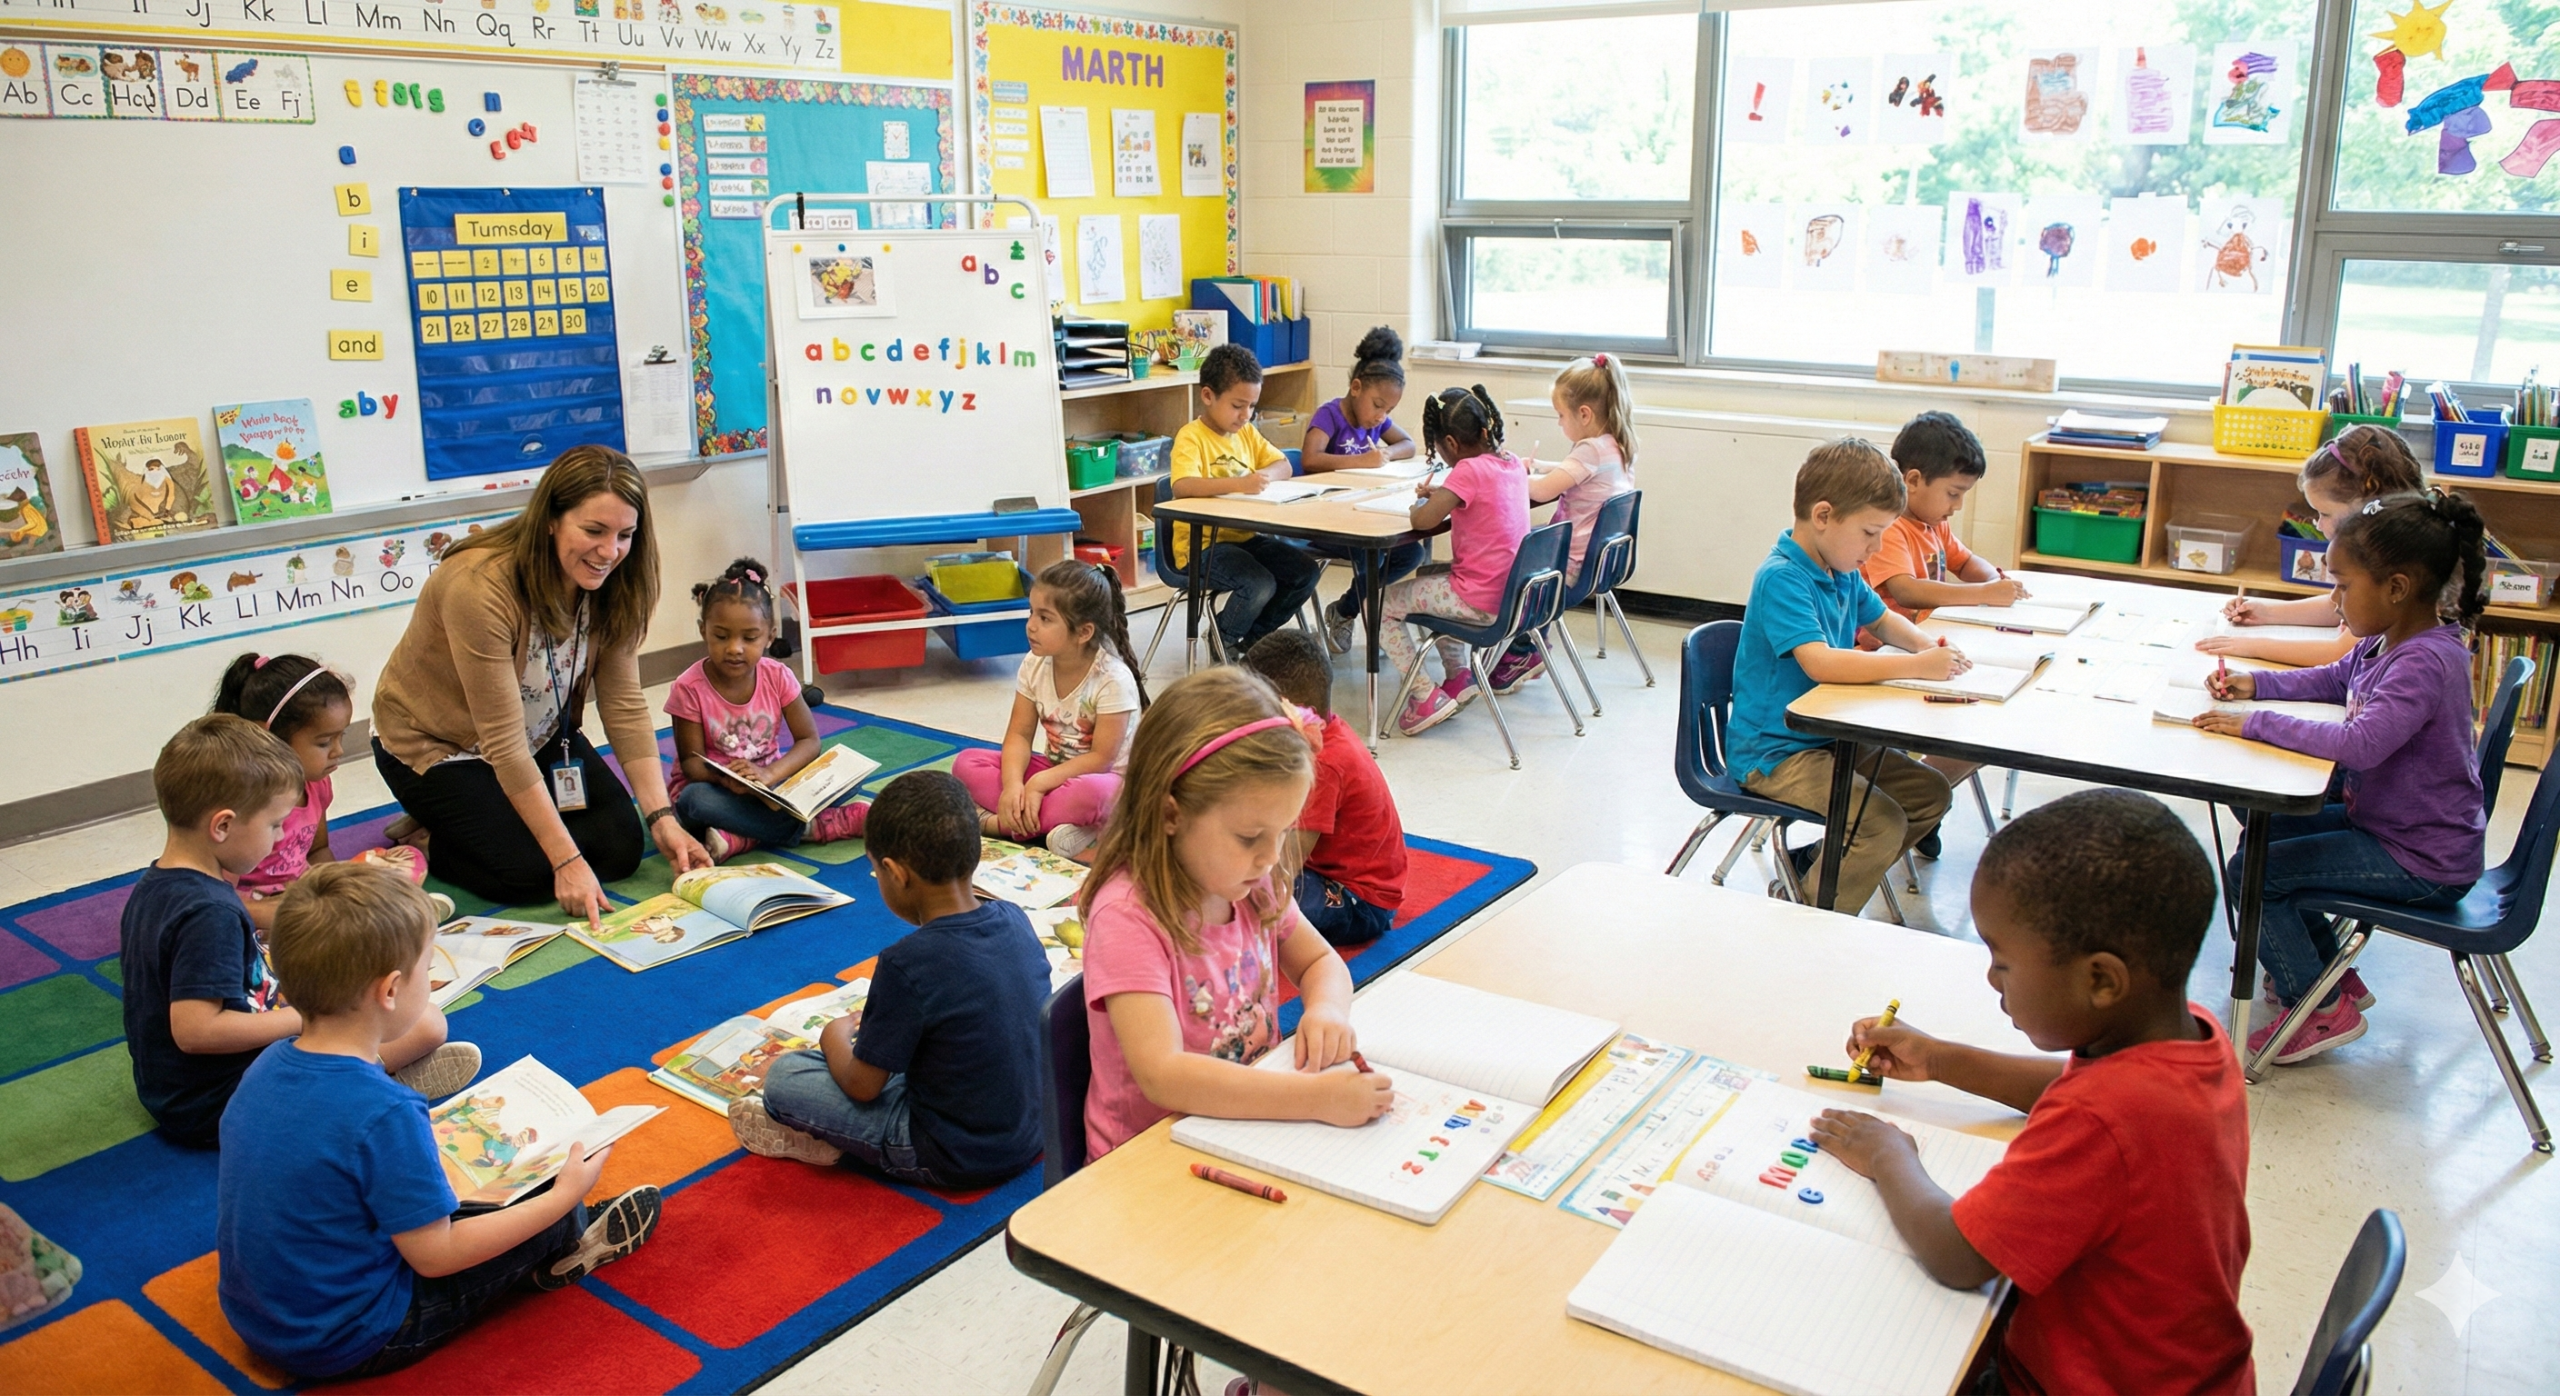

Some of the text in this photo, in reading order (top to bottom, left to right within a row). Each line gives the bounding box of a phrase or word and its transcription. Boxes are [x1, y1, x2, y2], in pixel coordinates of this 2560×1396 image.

[186, 0, 211, 28] Jj
[242, 0, 275, 22] Kk
[305, 0, 328, 26] Ll
[356, 3, 401, 30] Mm
[424, 9, 456, 33] Nn
[476, 13, 516, 47] Qq
[533, 16, 556, 40] Rr
[579, 20, 600, 43] Tt
[618, 23, 645, 47] Uu
[660, 26, 684, 49] Vv
[694, 28, 731, 52] Ww
[743, 33, 766, 54] Xx
[780, 36, 801, 64] Yy
[815, 38, 835, 60] Zz
[1062, 45, 1163, 88] MARTH
[3, 82, 38, 104] Ab
[61, 83, 93, 106] Cc
[177, 87, 209, 109] Dd
[235, 89, 261, 110] Ee
[281, 90, 301, 119] Fj
[347, 188, 362, 208] b
[362, 231, 368, 249] i
[467, 219, 553, 241] Tumsday
[346, 279, 359, 293] e
[426, 290, 438, 305] 10
[455, 289, 465, 303] 11
[482, 288, 497, 303] 12
[537, 285, 551, 299] 14
[565, 284, 578, 298] 15
[590, 282, 605, 297] 20
[1010, 282, 1025, 300] c
[426, 323, 440, 338] 21
[482, 319, 499, 334] 27
[510, 318, 528, 332] 28
[565, 314, 582, 329] 30
[338, 335, 376, 354] and
[338, 390, 398, 419] aby
[0, 571, 414, 665] Hh Ii Jj Kk Ll Mm Nn Oo
